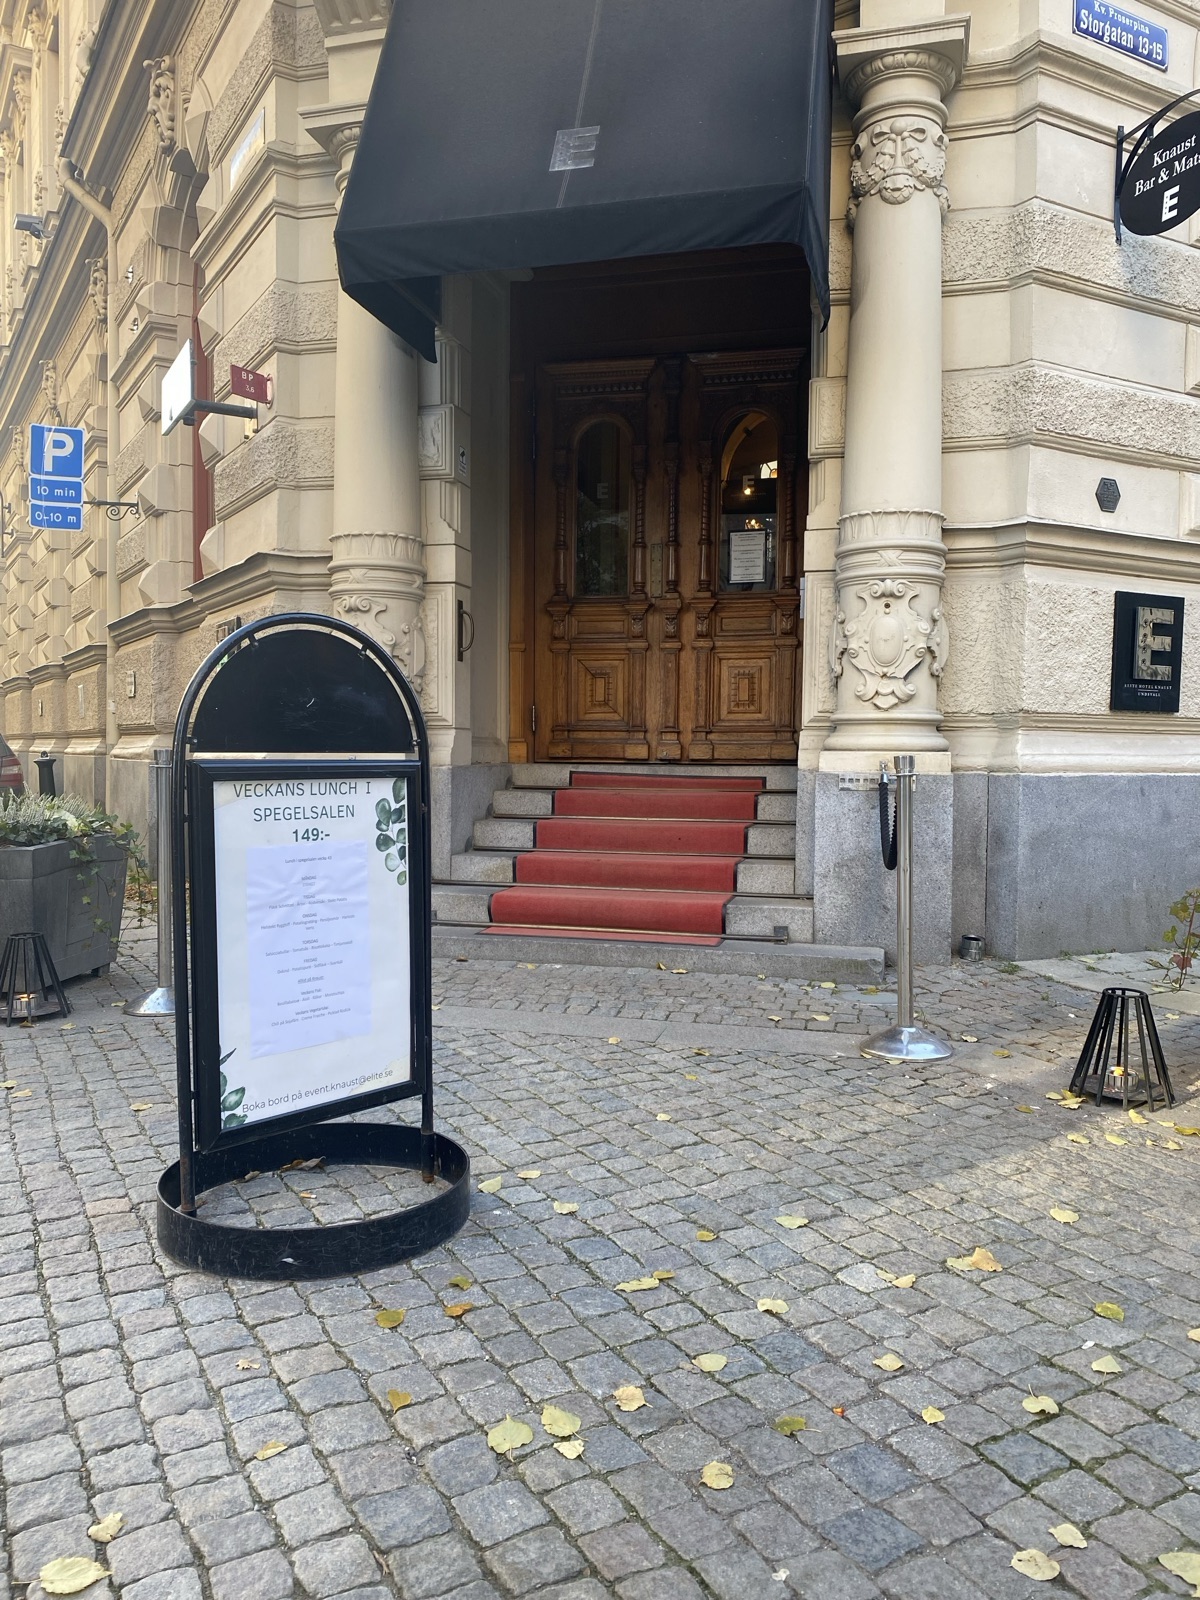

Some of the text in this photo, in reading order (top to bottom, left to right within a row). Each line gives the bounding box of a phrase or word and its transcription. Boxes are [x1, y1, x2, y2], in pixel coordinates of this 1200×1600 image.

[1093, 0, 1150, 34] Kv. Proserpina
[1080, 8, 1163, 61] Storgatan 13-15
[1151, 134, 1197, 169] Knaust
[1134, 177, 1156, 197] Bar
[1158, 167, 1170, 184] &
[1161, 184, 1180, 223] E
[43, 431, 74, 472] P
[36, 485, 75, 497] 10 min
[35, 511, 76, 523] 0-10 m
[1132, 606, 1175, 681] E
[233, 781, 371, 798] VECKANS LUNCH I
[253, 804, 355, 822] SPEGELSALEN
[292, 827, 330, 843] 149:-
[242, 1068, 394, 1114] Boka bord på event.knaust@elite.se
